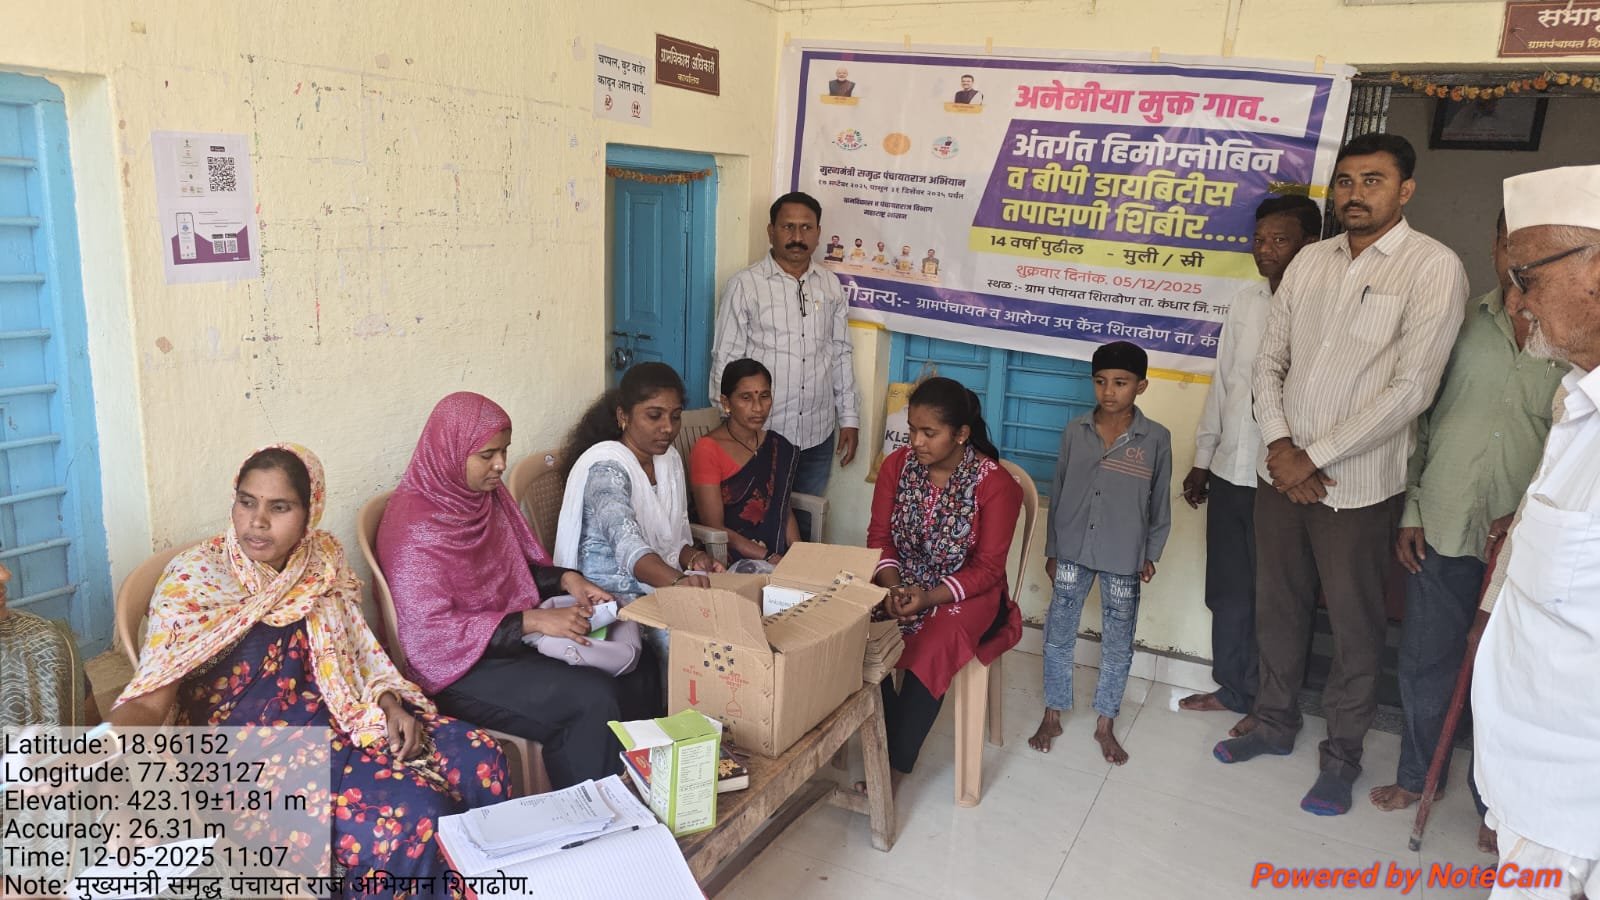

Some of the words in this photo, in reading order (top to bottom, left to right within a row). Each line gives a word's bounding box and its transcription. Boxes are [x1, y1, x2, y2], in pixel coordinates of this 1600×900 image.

[1014, 79, 1135, 114] अनेमीया
[1137, 89, 1200, 124] मुक्त
[1203, 93, 1280, 124] गाव..
[1013, 129, 1097, 163] अंतर्गत
[1101, 133, 1284, 174] हिमोग्लोबिन
[819, 165, 856, 177] मुख्यमंत्री
[857, 169, 881, 182] समृद्ध
[882, 170, 927, 184] पंचायतराज
[929, 175, 966, 188] अभियान
[1007, 166, 1028, 190] व
[1031, 162, 1090, 196] बीपी
[1094, 169, 1238, 207] डायबिटीस
[1002, 198, 1111, 231] तपासणी
[1115, 202, 1249, 244] शिबीर....
[991, 235, 1006, 248] 14
[1010, 236, 1039, 251] वर्षा
[1041, 238, 1084, 257] पुढील
[1123, 247, 1160, 266] मुली
[1015, 264, 1061, 280] शुक्रवार
[1113, 276, 1202, 295] 05/12/2025
[1024, 283, 1045, 296] ग्राम
[1048, 285, 1087, 301] पंचायत
[1088, 290, 1136, 306] शिराढोण
[1157, 296, 1190, 313] कंधार
[916, 297, 987, 319] ग्रामपंचायत
[990, 307, 1002, 321] व
[1004, 306, 1050, 327] आरोग्य
[1053, 316, 1073, 331] उप
[1076, 314, 1104, 335] केंद्र
[1106, 321, 1170, 345] शिराढोण
